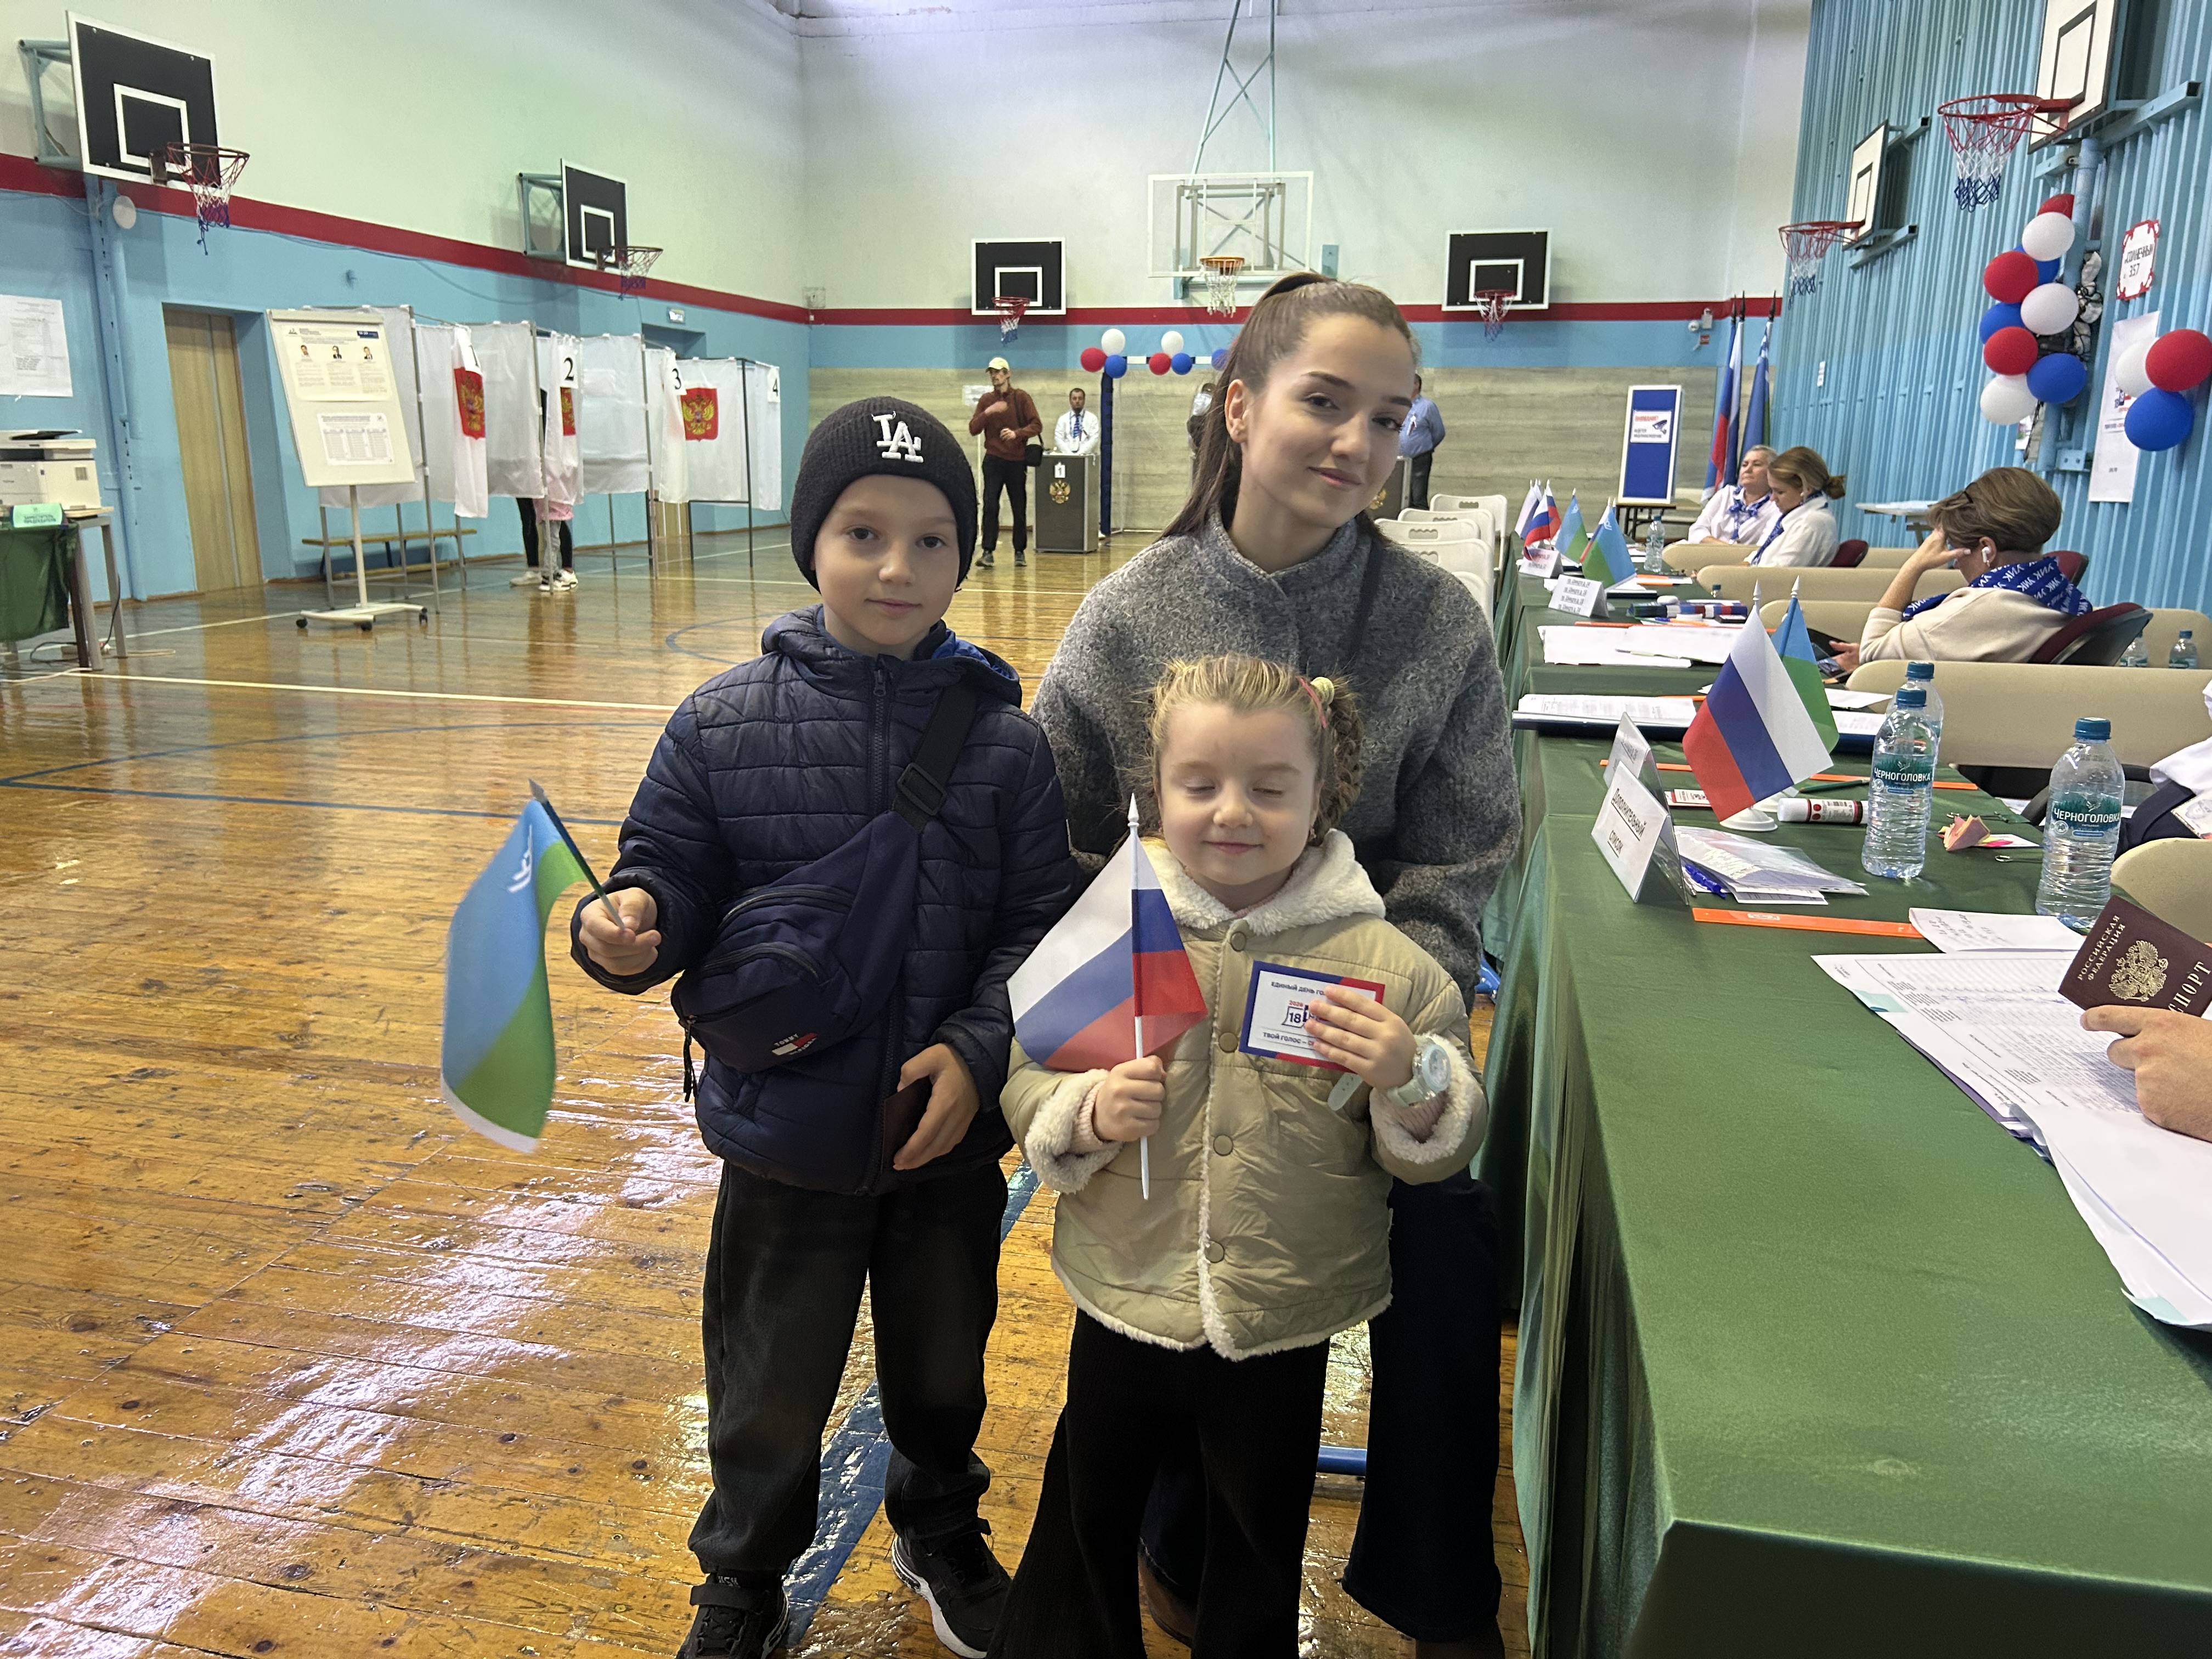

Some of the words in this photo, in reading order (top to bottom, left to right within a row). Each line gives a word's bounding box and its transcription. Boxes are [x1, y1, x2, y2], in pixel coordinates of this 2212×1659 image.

[2129, 263, 2140, 277] 357
[563, 357, 574, 381] 2
[672, 368, 681, 390] 3
[772, 378, 778, 397] 4
[871, 411, 924, 463] LA
[1058, 467, 1062, 476] 1
[2003, 564, 2024, 582] УИК
[2033, 563, 2054, 580] УИК
[2017, 577, 2035, 591] УИК
[2045, 577, 2061, 592] УИК
[1874, 767, 1931, 781] ЧЕРНОГОЛОВКА
[1612, 788, 1646, 837] Дополнительный
[2054, 808, 2119, 823] ЧЕРНОГОЛОВКА
[1609, 830, 1623, 854] список
[2077, 915, 2120, 981] РОССИЙСКАЯ
[2087, 924, 2126, 981] ФЕДЕРАЦИЯ
[2168, 961, 2211, 1013] СПОРТ
[1289, 1012, 1301, 1023] 18
[774, 1034, 799, 1047] TOMMY
[1263, 1032, 1280, 1040] ТВОЙ
[1281, 1035, 1301, 1043] ГОЛОС
